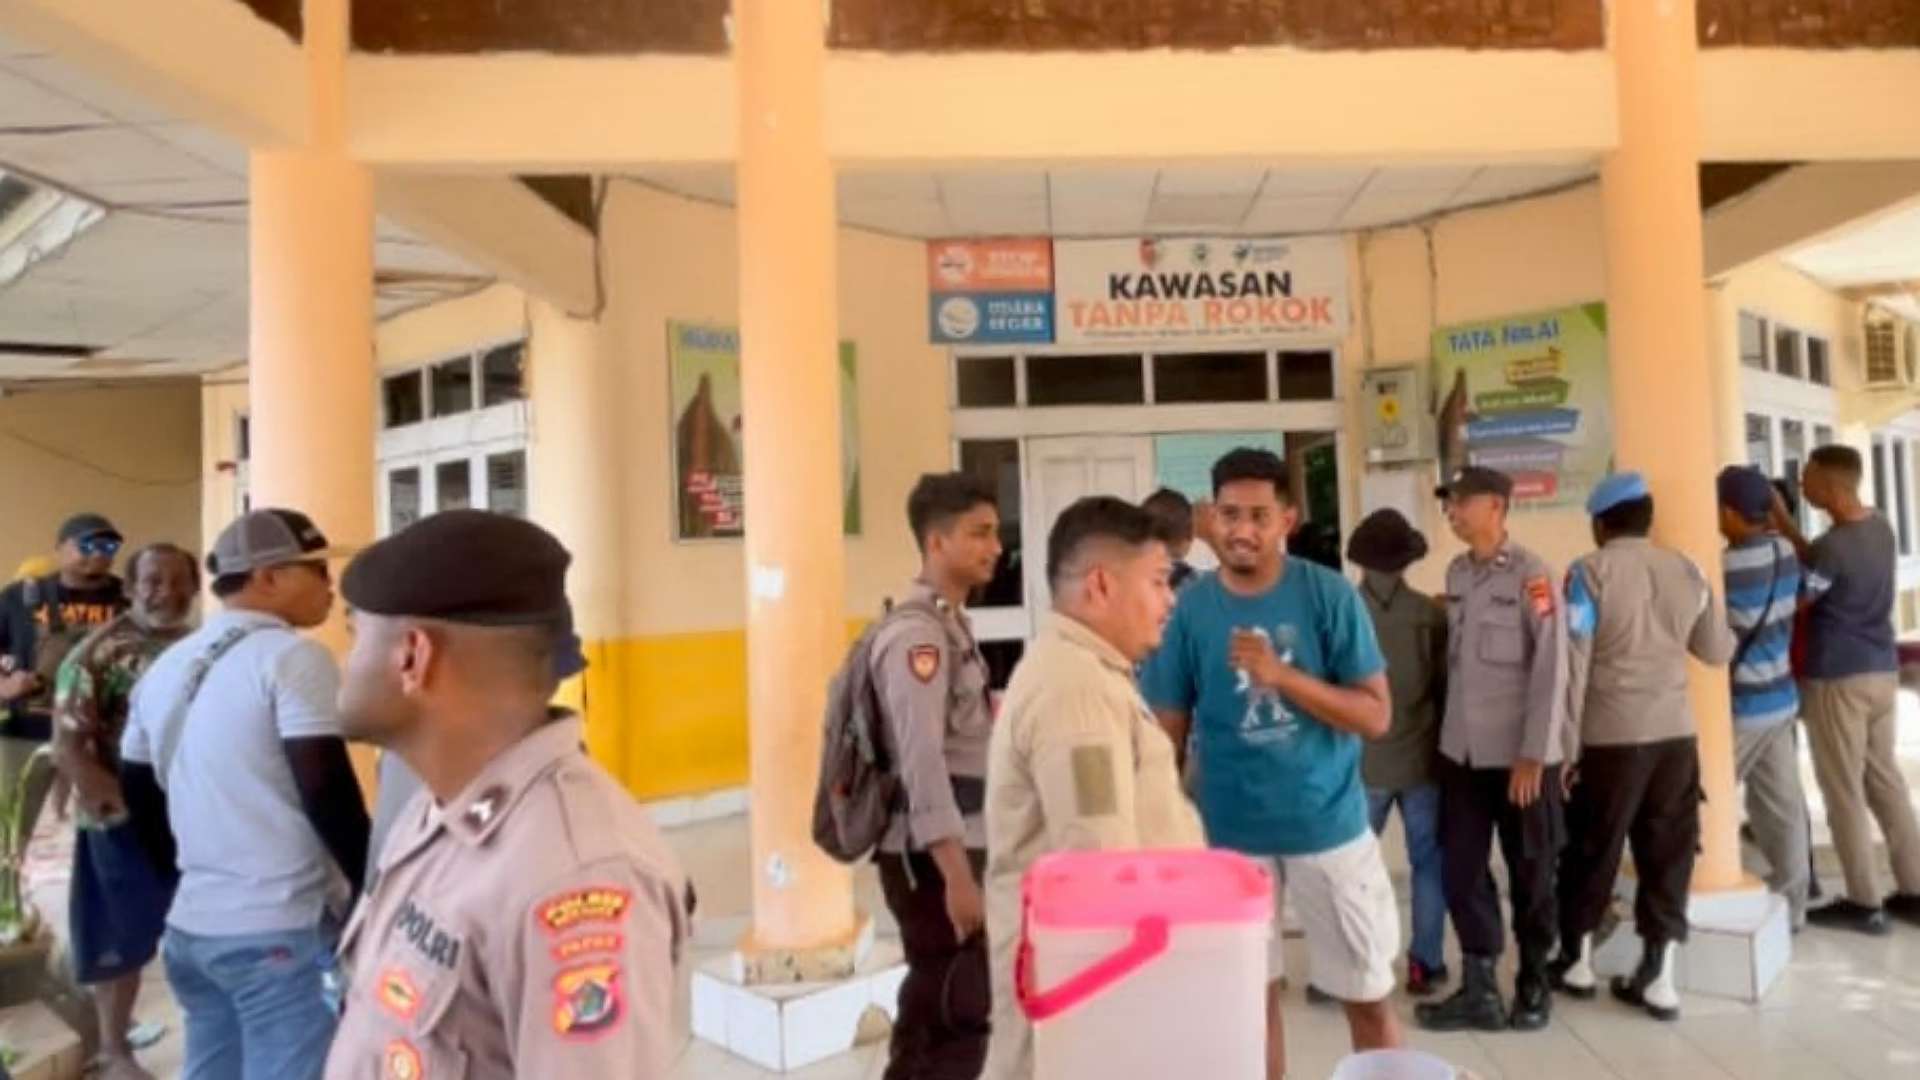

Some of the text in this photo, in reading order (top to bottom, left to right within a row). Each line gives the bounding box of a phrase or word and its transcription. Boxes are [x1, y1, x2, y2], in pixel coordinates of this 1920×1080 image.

[1108, 270, 1292, 300] KAWASAN
[1067, 296, 1334, 328] TANPA ROKOK
[1449, 316, 1560, 353] TATA NILAI
[398, 902, 459, 969] POLRI
